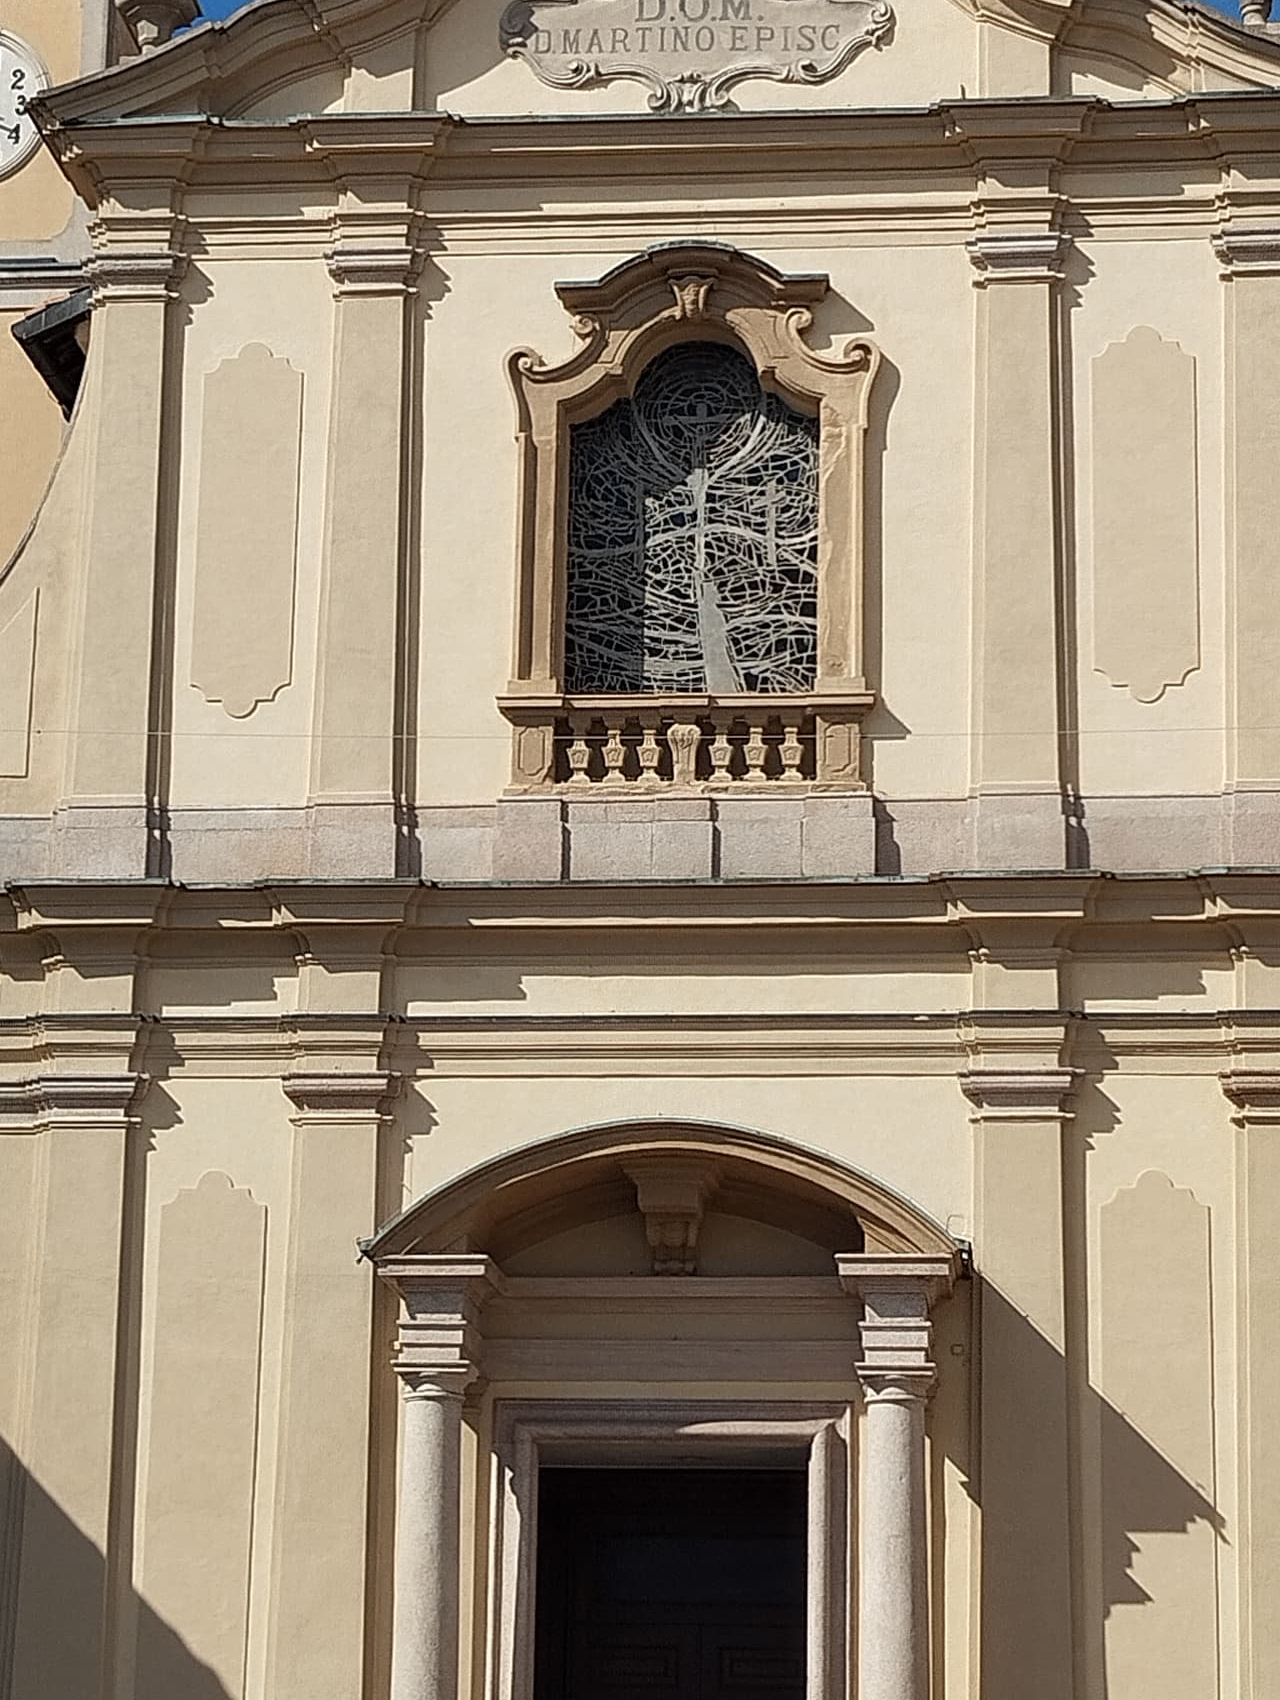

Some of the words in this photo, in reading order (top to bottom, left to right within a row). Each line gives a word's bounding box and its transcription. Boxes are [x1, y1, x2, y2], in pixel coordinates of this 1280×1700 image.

[729, 24, 841, 52] EPISC
[10, 69, 25, 91] 2
[14, 94, 28, 116] 3
[6, 123, 21, 145] 4
